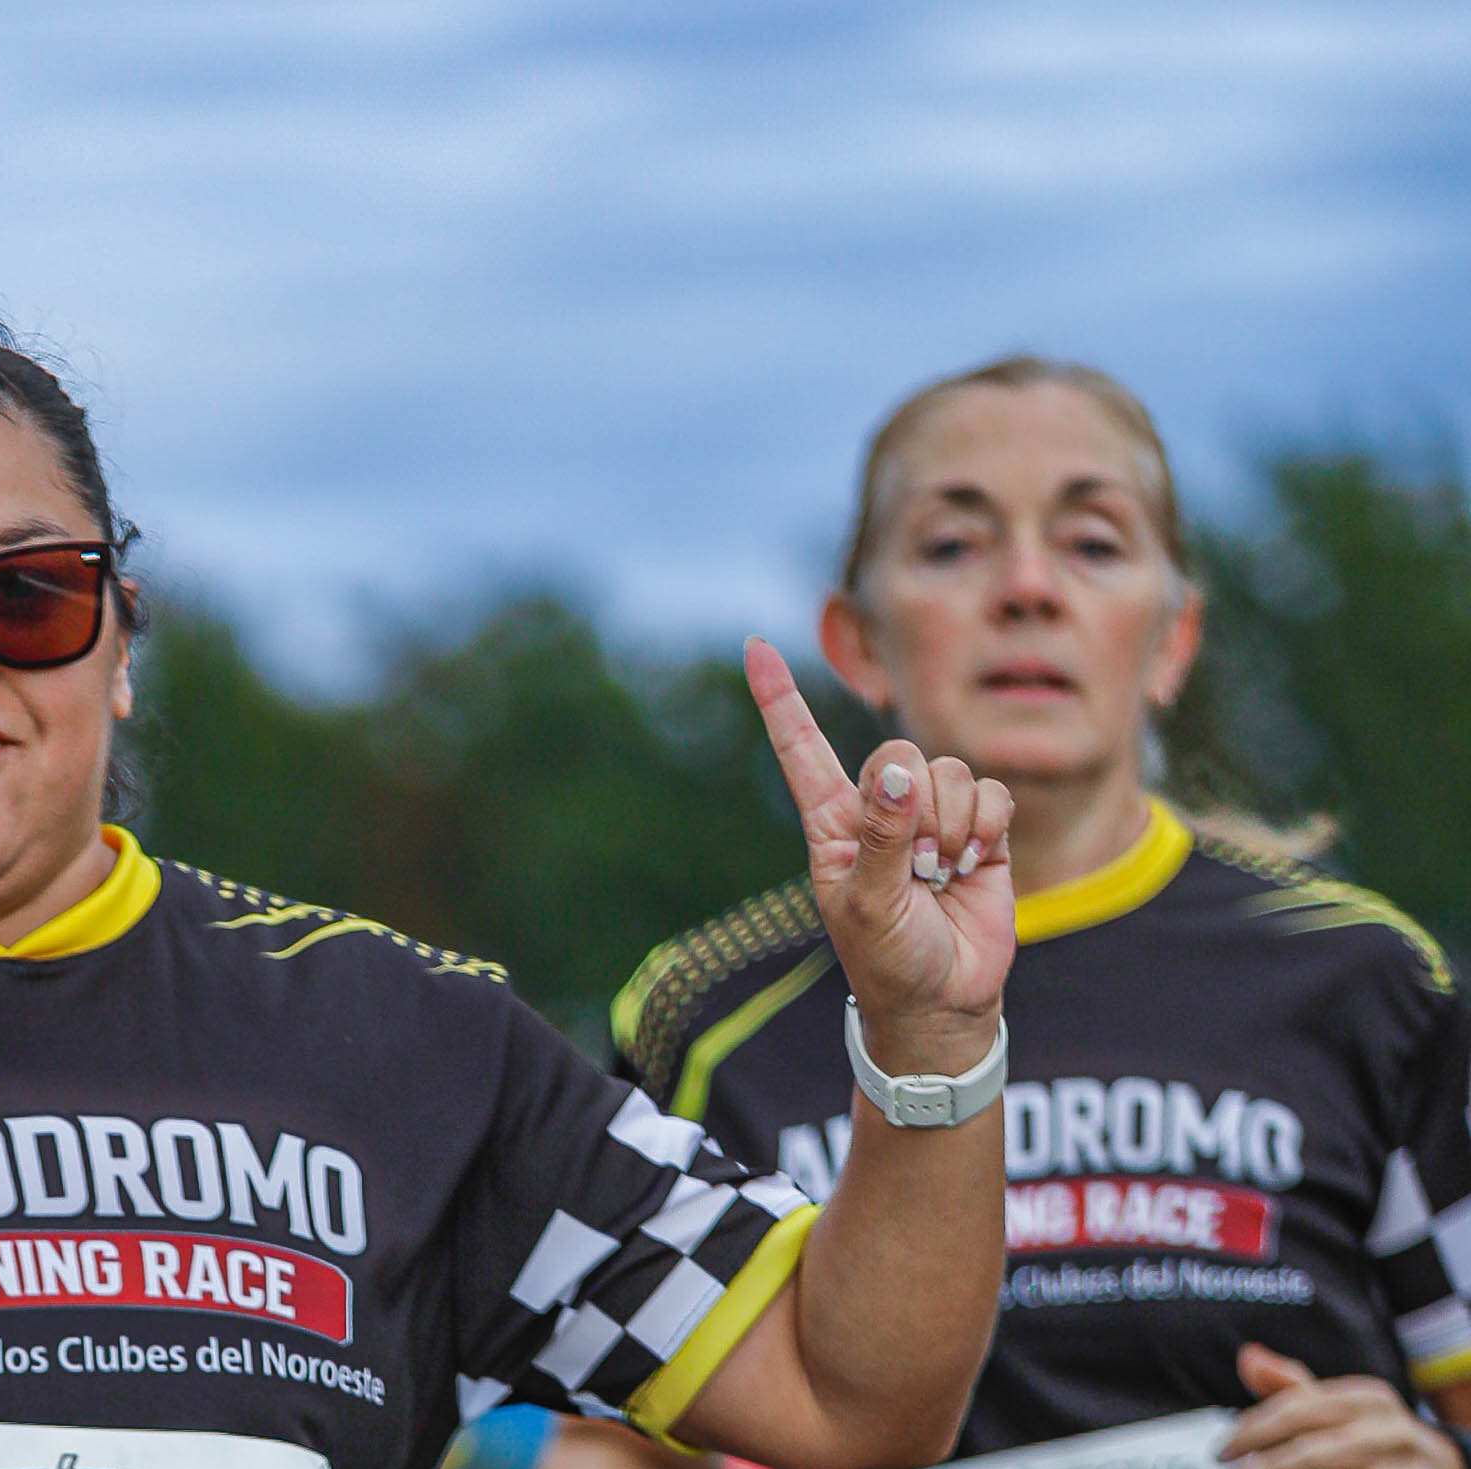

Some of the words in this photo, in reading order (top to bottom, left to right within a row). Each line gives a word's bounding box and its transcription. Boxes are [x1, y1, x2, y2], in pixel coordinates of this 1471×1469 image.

[139, 1239, 297, 1319] RACE
[58, 1335, 188, 1373] Clubes
[195, 1335, 254, 1375] del
[261, 1341, 385, 1406] Noroeste
